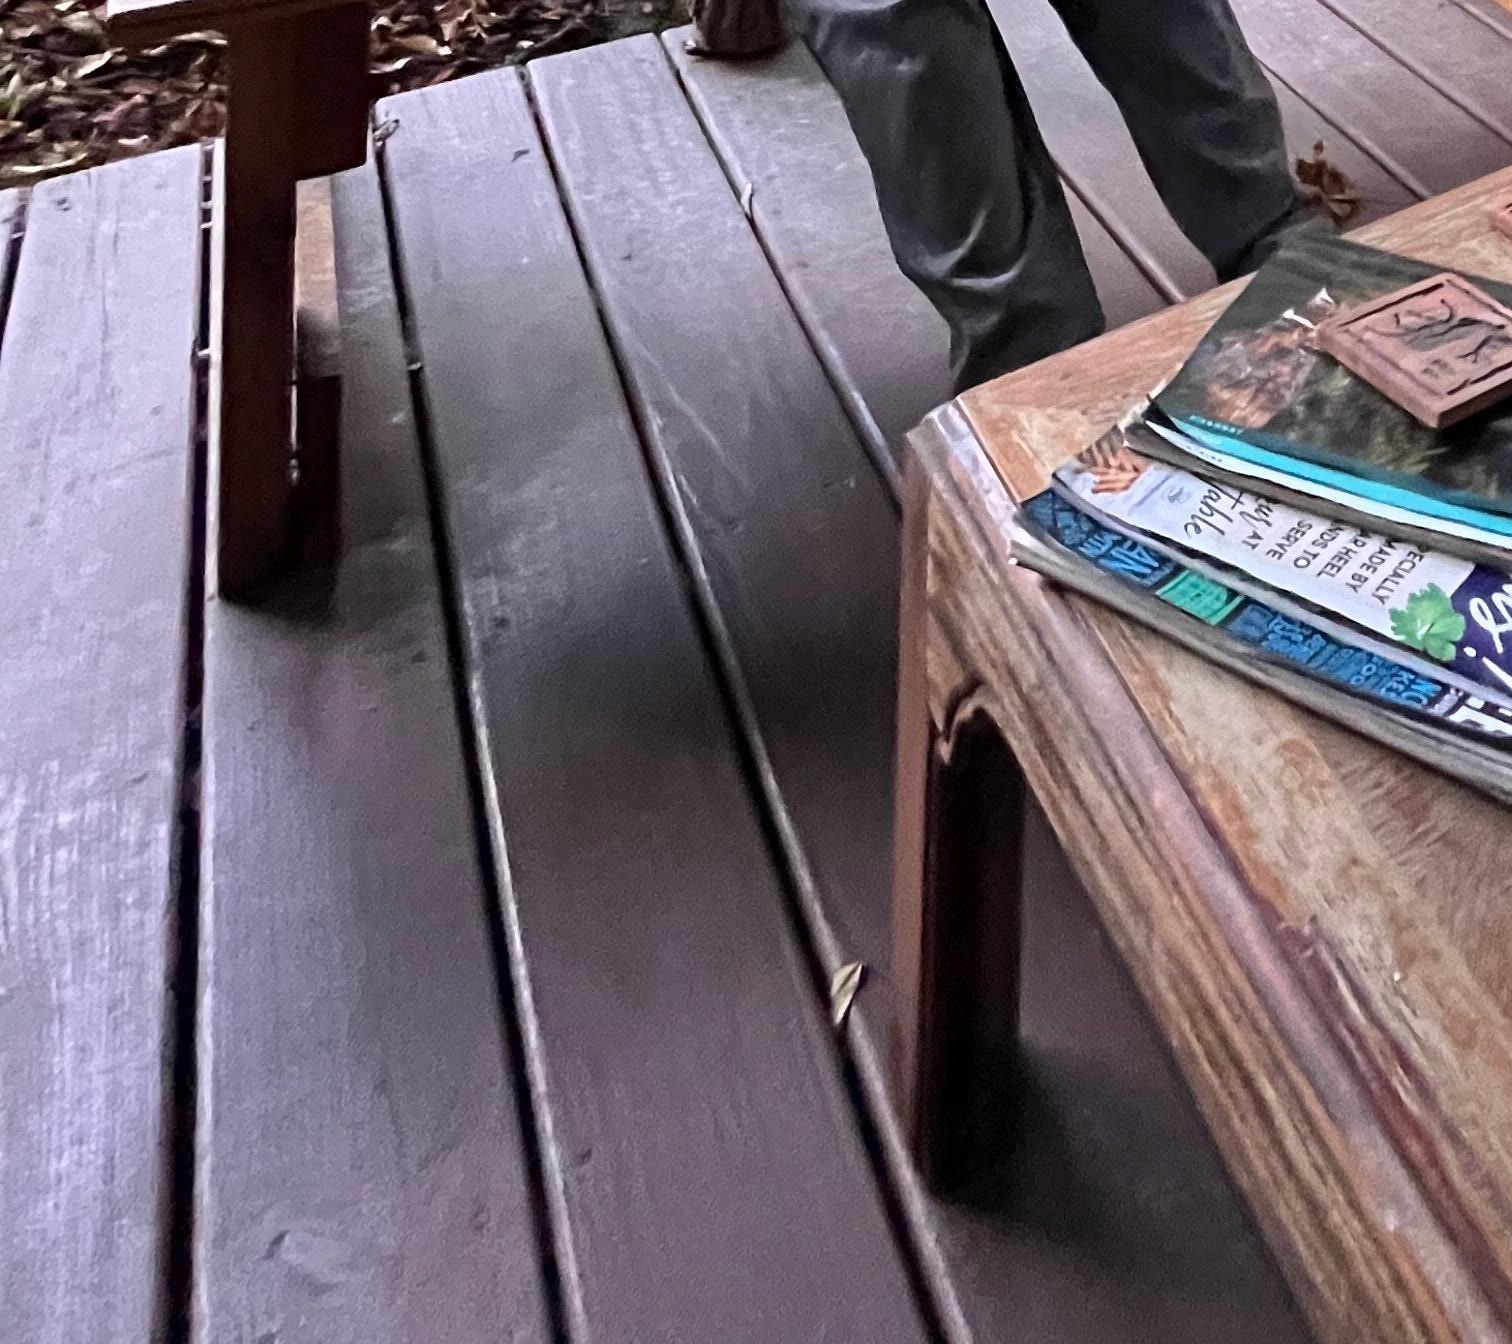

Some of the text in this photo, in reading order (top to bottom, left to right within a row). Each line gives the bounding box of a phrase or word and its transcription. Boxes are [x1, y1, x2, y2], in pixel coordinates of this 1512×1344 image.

[1241, 530, 1263, 551] AT
[1265, 519, 1313, 562] SERVE
[1293, 548, 1320, 570] TO
[1316, 545, 1354, 580] HEEL
[1344, 572, 1370, 595] BY
[1371, 550, 1425, 605] ECIALLY
